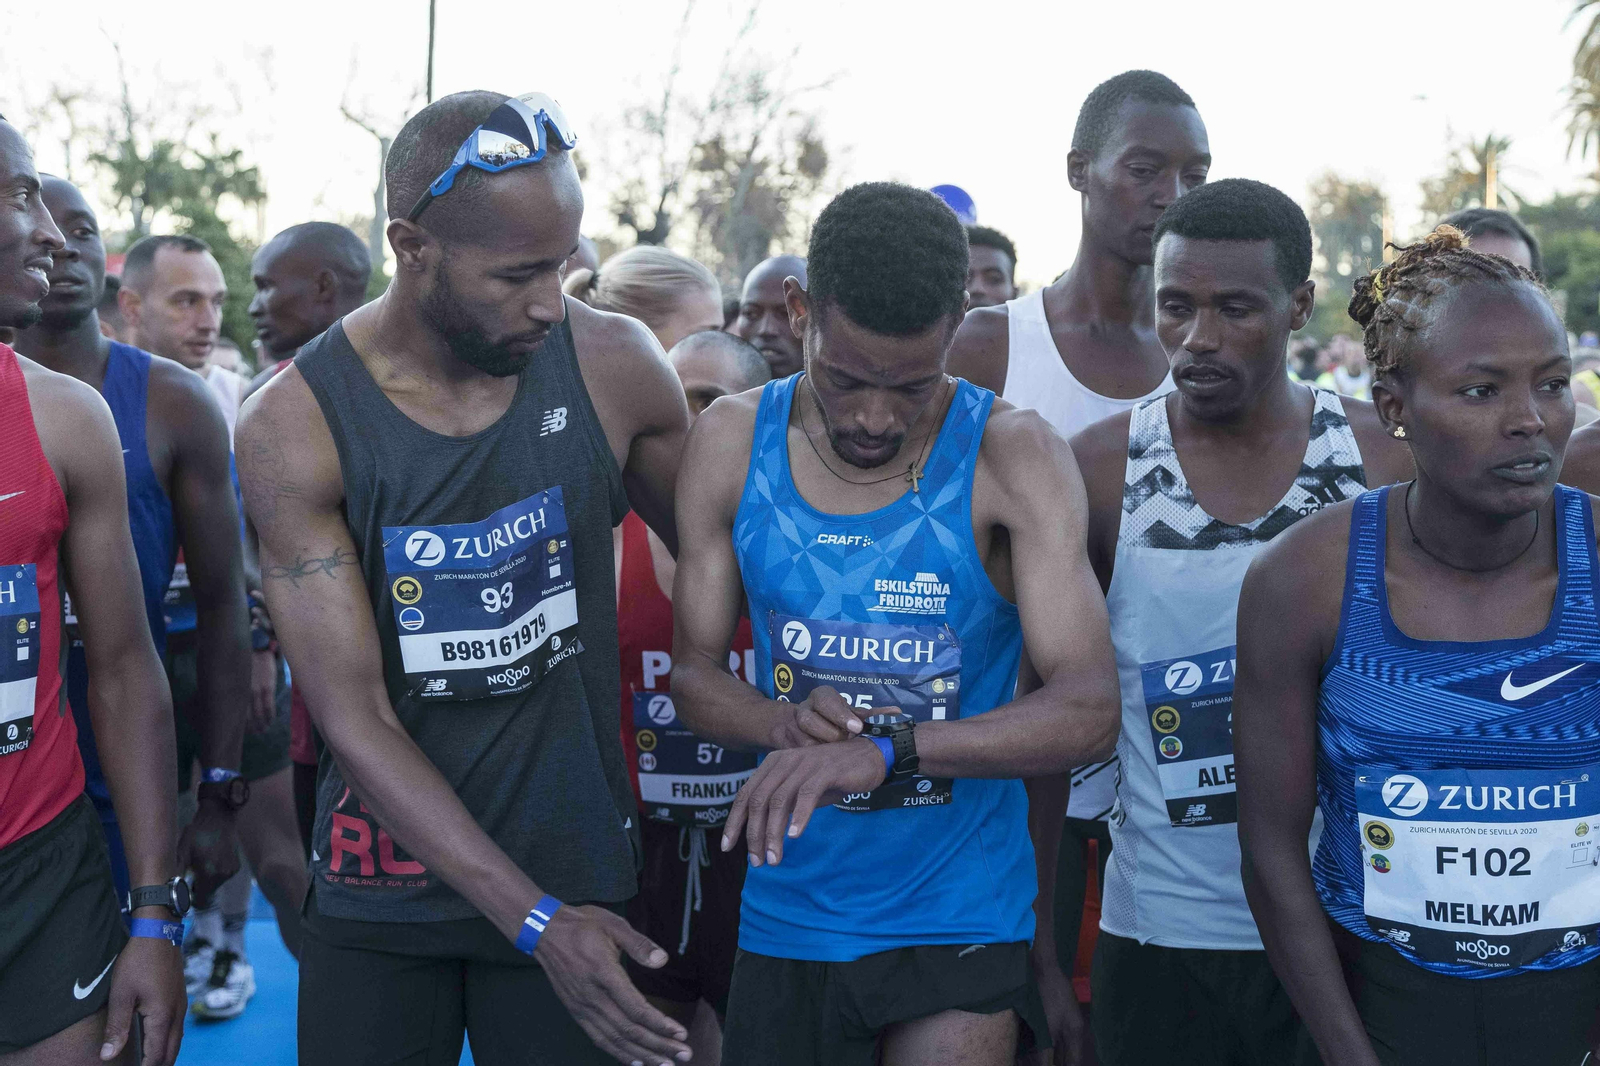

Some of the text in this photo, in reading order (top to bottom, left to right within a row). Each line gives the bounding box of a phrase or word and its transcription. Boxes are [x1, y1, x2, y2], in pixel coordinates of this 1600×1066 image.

[452, 507, 547, 560] ZURICH
[817, 533, 863, 546] CRAFT
[434, 555, 527, 581] ZURICH MARATÓN DE SEVILLA 2020
[480, 581, 514, 613] 93
[541, 581, 572, 597] Hombre-M
[874, 578, 951, 595] ESKILSTUNA
[879, 593, 947, 609] FRIIDROTT
[440, 612, 547, 662] B98161979
[547, 646, 576, 669] ZURICH
[818, 634, 935, 664] ZURICH
[801, 669, 817, 679] ZURICH
[818, 672, 848, 683] MARATÓN
[848, 676, 858, 684] DE
[858, 677, 883, 685] SEVILLA
[1191, 699, 1214, 708] ZURICH
[696, 743, 724, 765] 57
[671, 777, 750, 799] FRANKLI
[1438, 783, 1577, 811] ZURICH
[903, 794, 944, 806] ZURICH
[1409, 826, 1538, 836] ZURICH MARATÓN DE SEVILLA 2020
[1570, 841, 1585, 849] ELITE
[1436, 846, 1532, 877] F102
[325, 874, 340, 883] NEW
[344, 877, 382, 887] BALANCE
[1425, 900, 1540, 927] MELKAM
